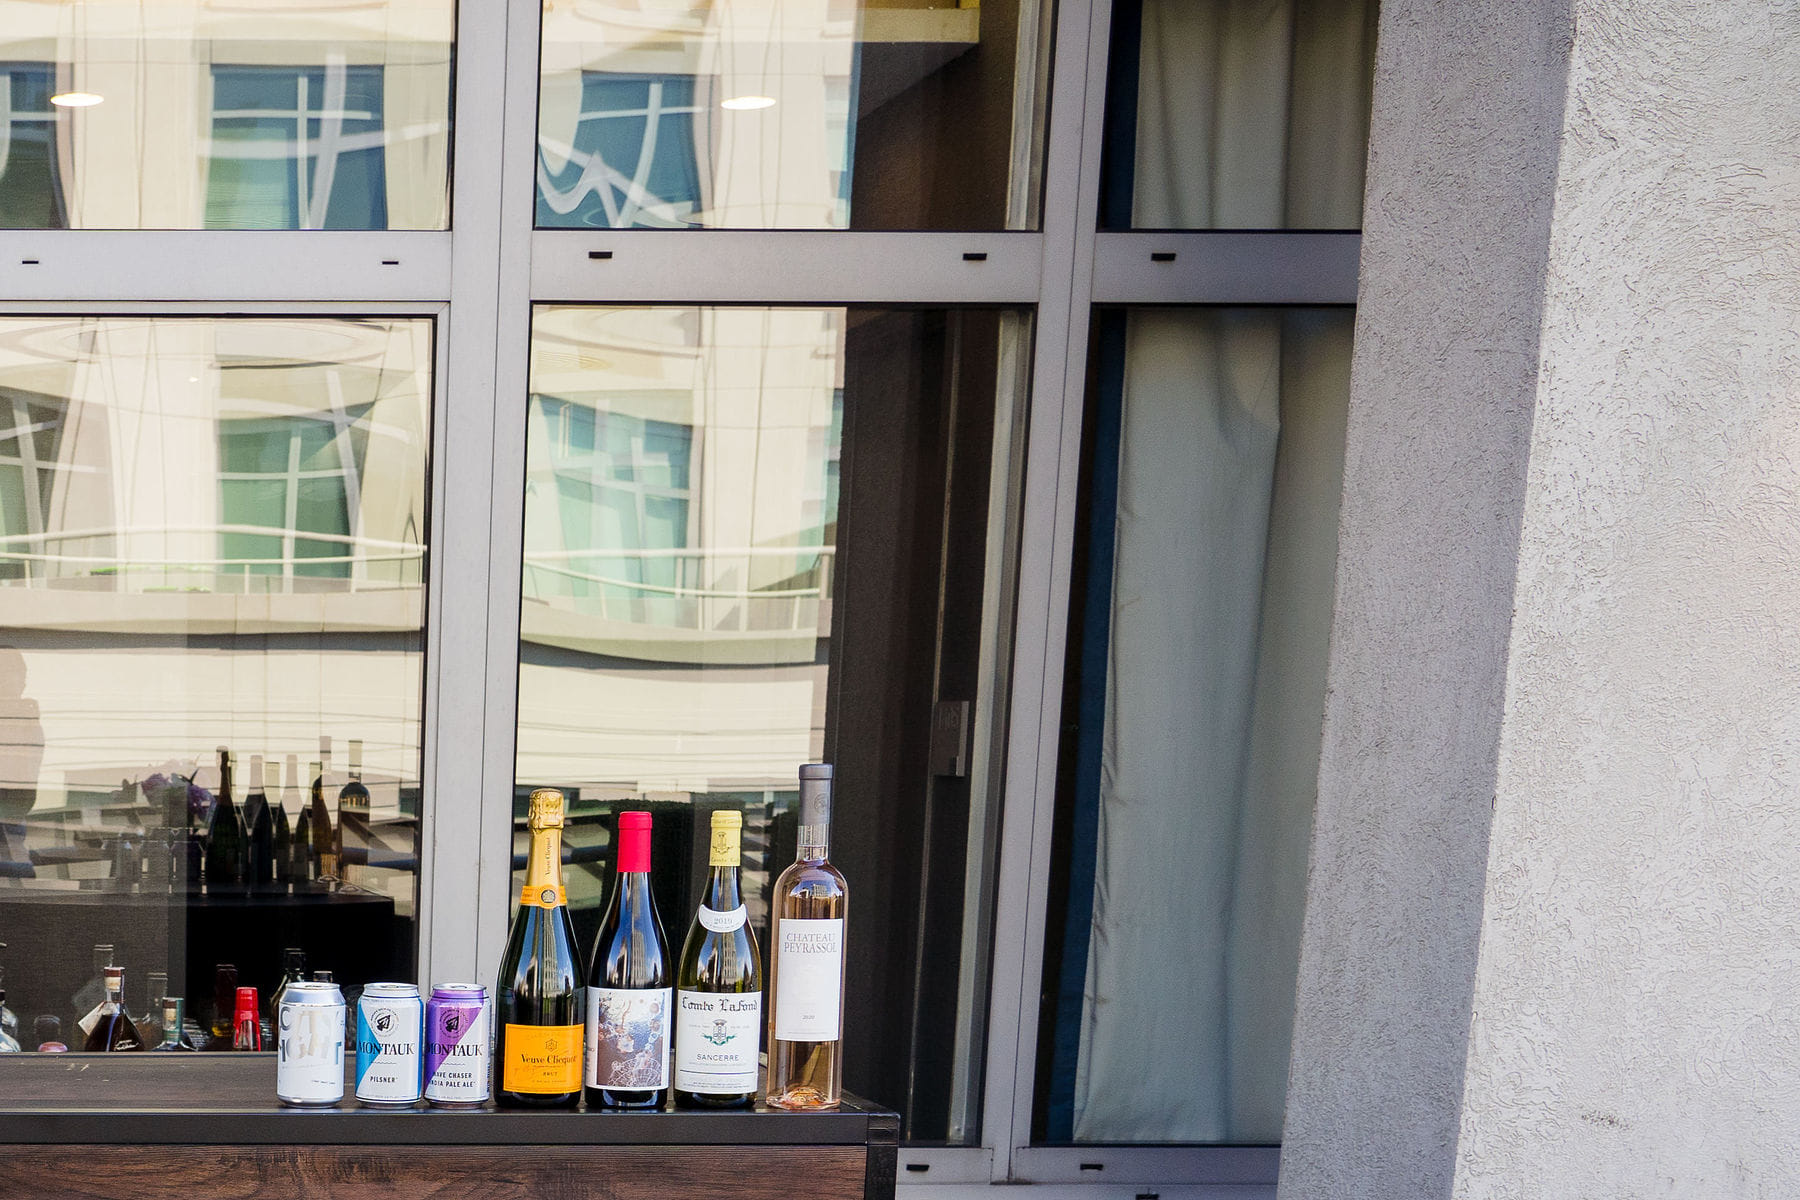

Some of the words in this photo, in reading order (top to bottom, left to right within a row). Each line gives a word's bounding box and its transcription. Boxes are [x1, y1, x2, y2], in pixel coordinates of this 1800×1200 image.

[786, 932, 835, 942] CHATEAU
[784, 941, 837, 953] PEYRASSOL
[358, 1040, 415, 1055] MONTAUK
[521, 1053, 545, 1063] Veuve
[547, 1055, 576, 1065] Clicquot
[696, 1053, 739, 1062] SANCERRE
[370, 1075, 396, 1083] PILSNER
